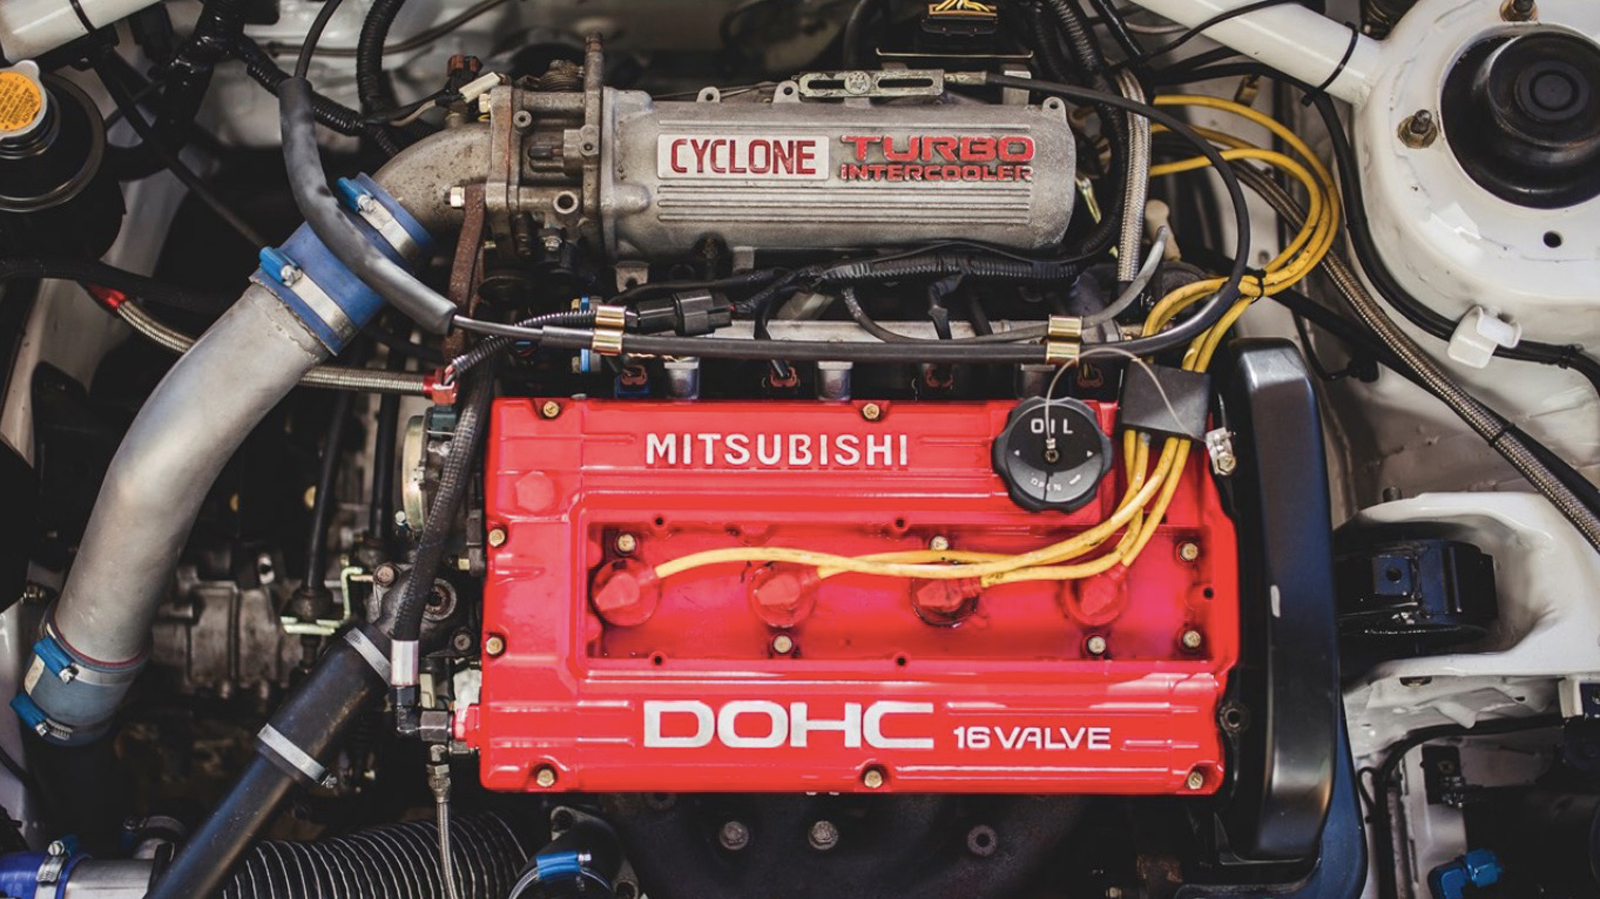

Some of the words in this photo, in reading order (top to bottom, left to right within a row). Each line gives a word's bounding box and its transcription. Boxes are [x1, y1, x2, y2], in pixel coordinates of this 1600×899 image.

[670, 138, 816, 174] CYCLONE
[841, 134, 1035, 162] TURBO
[840, 163, 1034, 182] INTERCOOLER
[1030, 418, 1074, 434] OIL
[645, 433, 908, 466] MITSUBISHI
[643, 700, 934, 749] DOHC
[953, 726, 991, 749] 16
[993, 726, 1112, 750] VALVE
